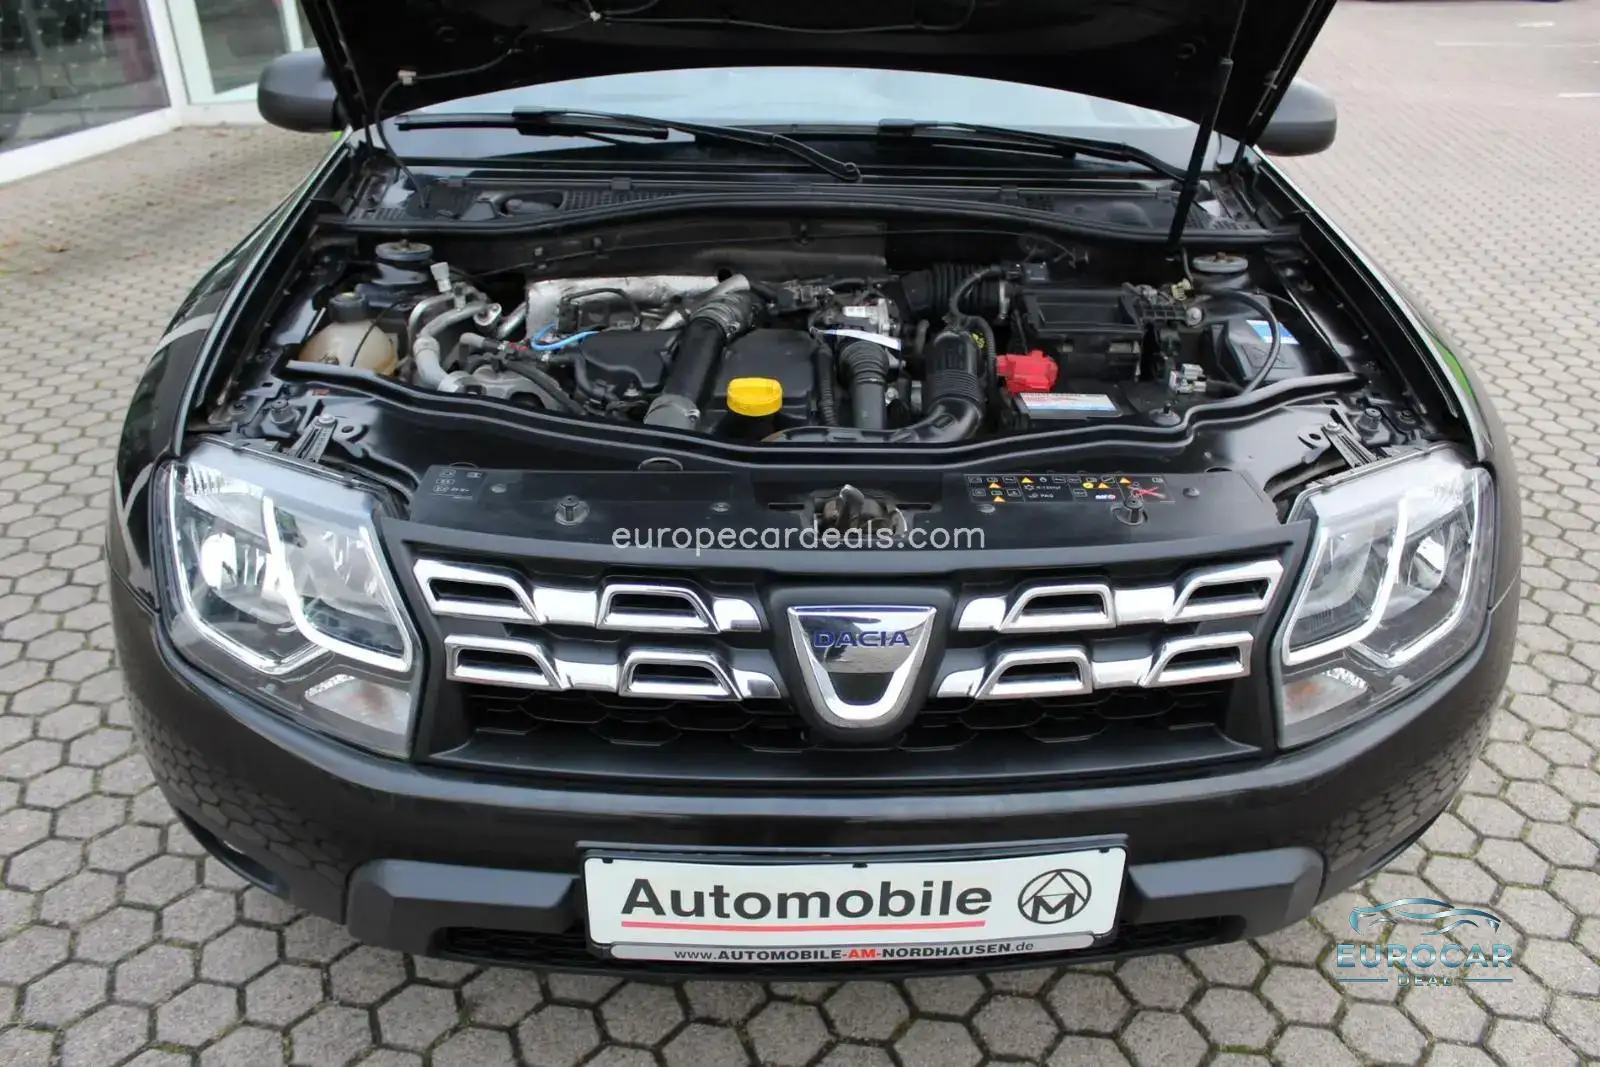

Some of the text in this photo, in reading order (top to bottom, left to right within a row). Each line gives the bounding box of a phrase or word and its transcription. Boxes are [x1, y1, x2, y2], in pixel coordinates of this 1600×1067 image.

[814, 630, 911, 648] DACIA
[621, 877, 993, 920] Automobile
[674, 941, 1035, 961] www.AUTOMOBILE-AM-NORDHAUSEN.de
